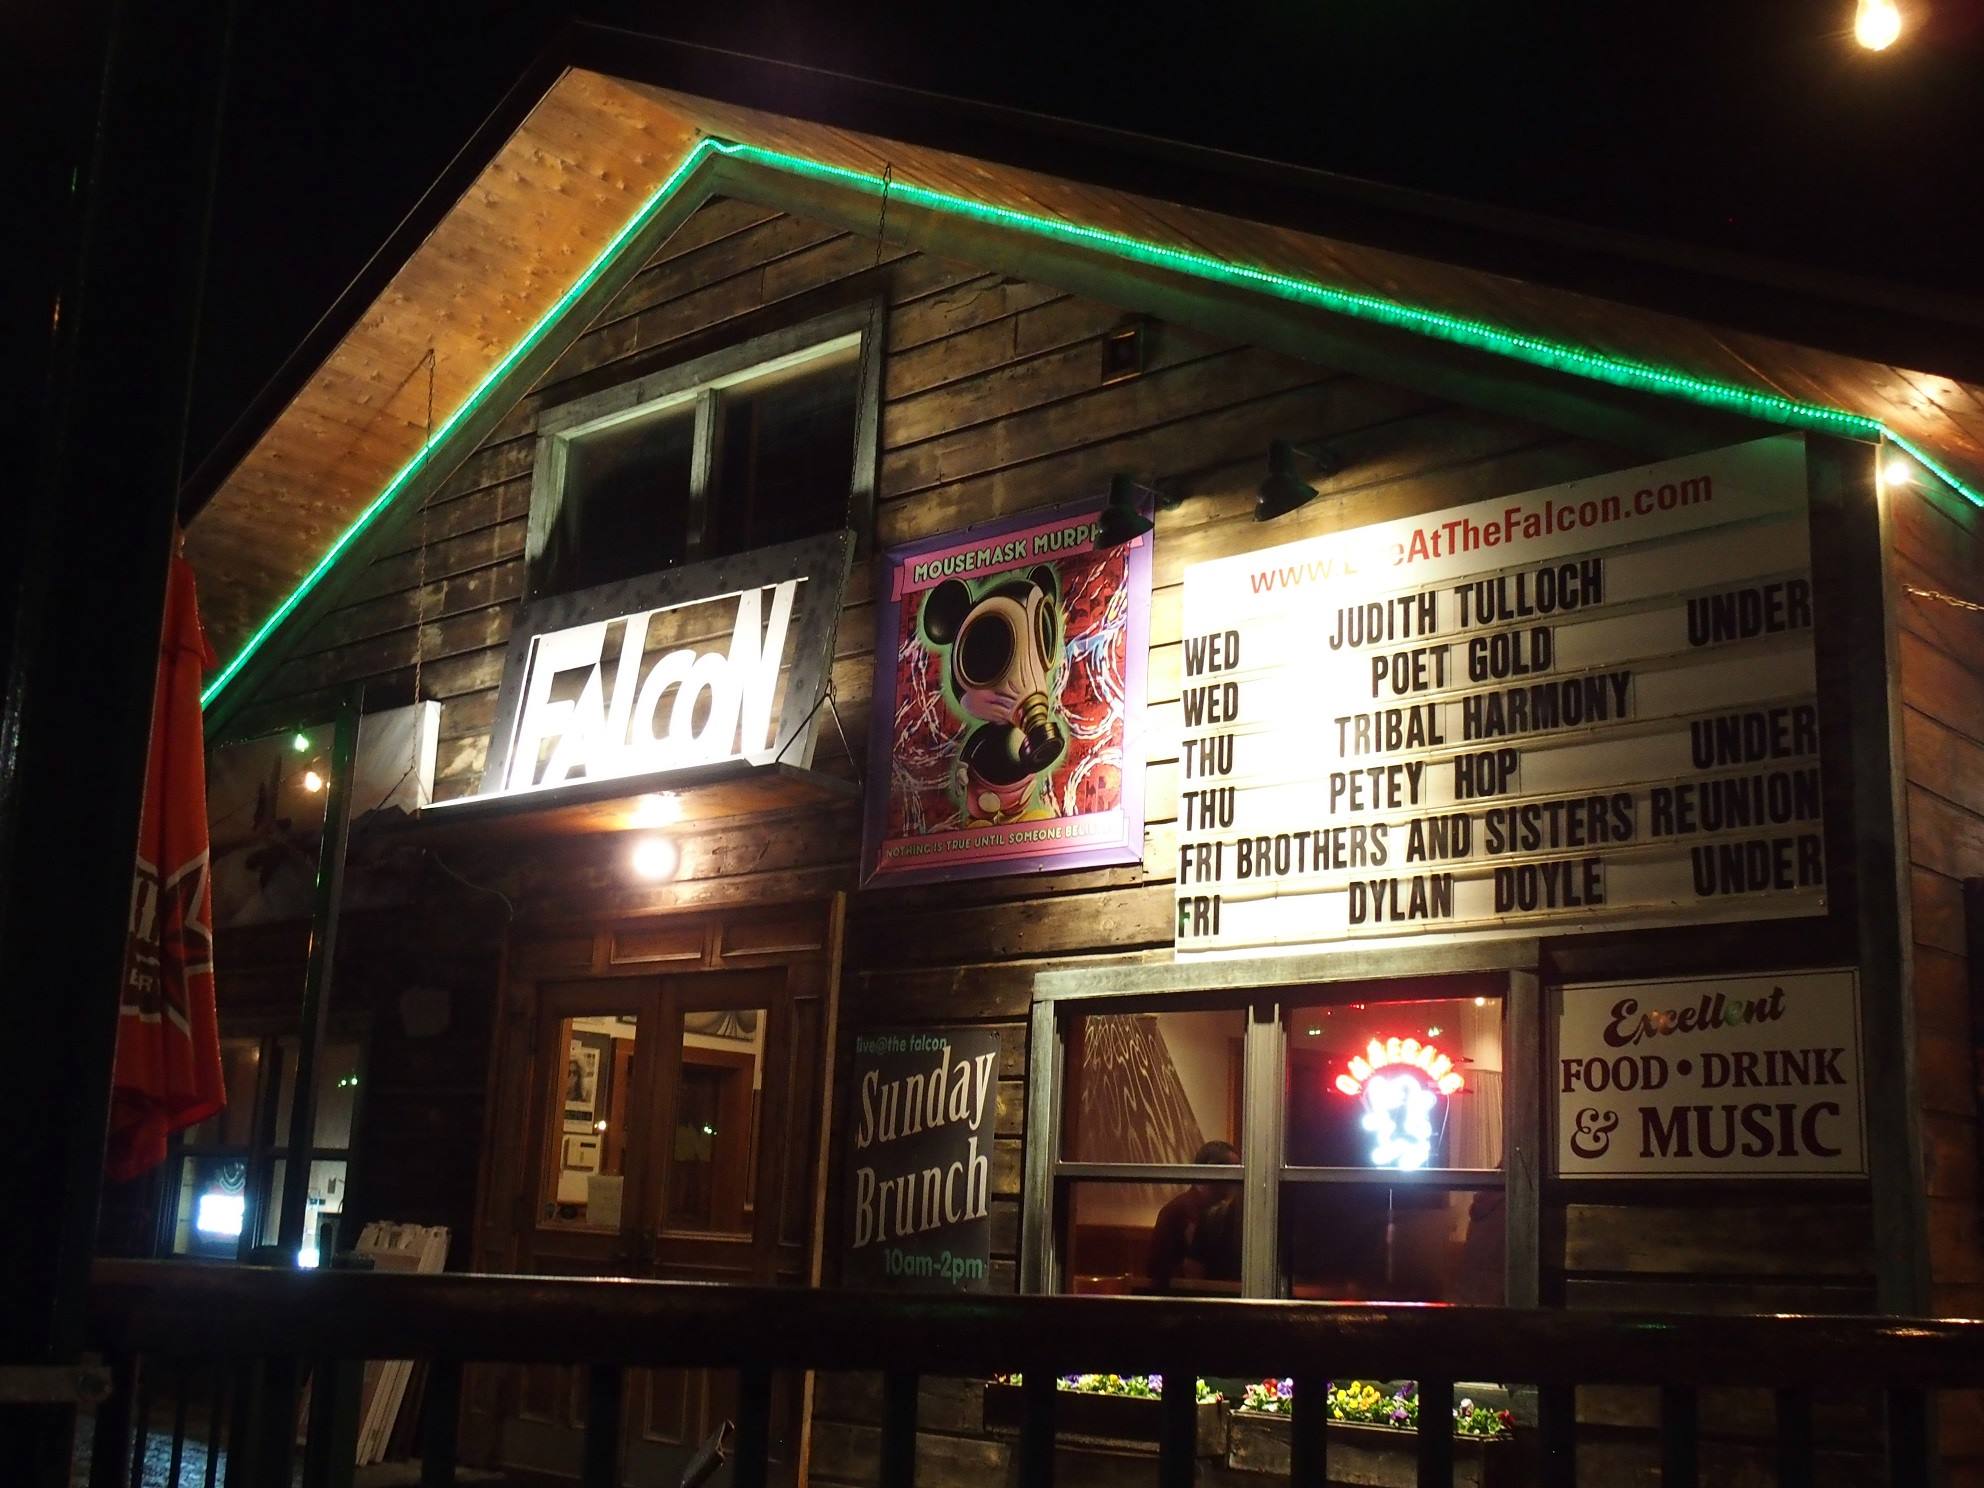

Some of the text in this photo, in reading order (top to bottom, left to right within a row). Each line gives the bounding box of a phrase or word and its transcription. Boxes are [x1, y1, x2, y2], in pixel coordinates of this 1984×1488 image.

[1034, 521, 1102, 556] MURPH
[1182, 578, 1812, 727] WED POET GOLD UNDER
[1184, 558, 1602, 677] WED JUDITH TULLOCH
[1182, 670, 1631, 779] THU TRIBAL HARMONY
[1182, 704, 1817, 831] THU PETEY HOP UNDER
[886, 844, 932, 858] NOTHING
[946, 838, 971, 851] TRUE
[974, 834, 1005, 847] UNTIL
[1008, 827, 1062, 844] SOMEONE
[1180, 769, 1820, 885] FRI BROTHERS AND SISTERS REUNION
[1178, 834, 1823, 938] FRI DYLAN DOYLE UNDER
[910, 1033, 948, 1052] falcon
[1561, 1048, 1848, 1093] FOOD DRINK
[857, 1045, 997, 1149] Sunday
[1570, 1102, 1843, 1159] & MUSIC
[852, 1136, 989, 1249] Brunch
[883, 1247, 984, 1284] 10am-2pm
